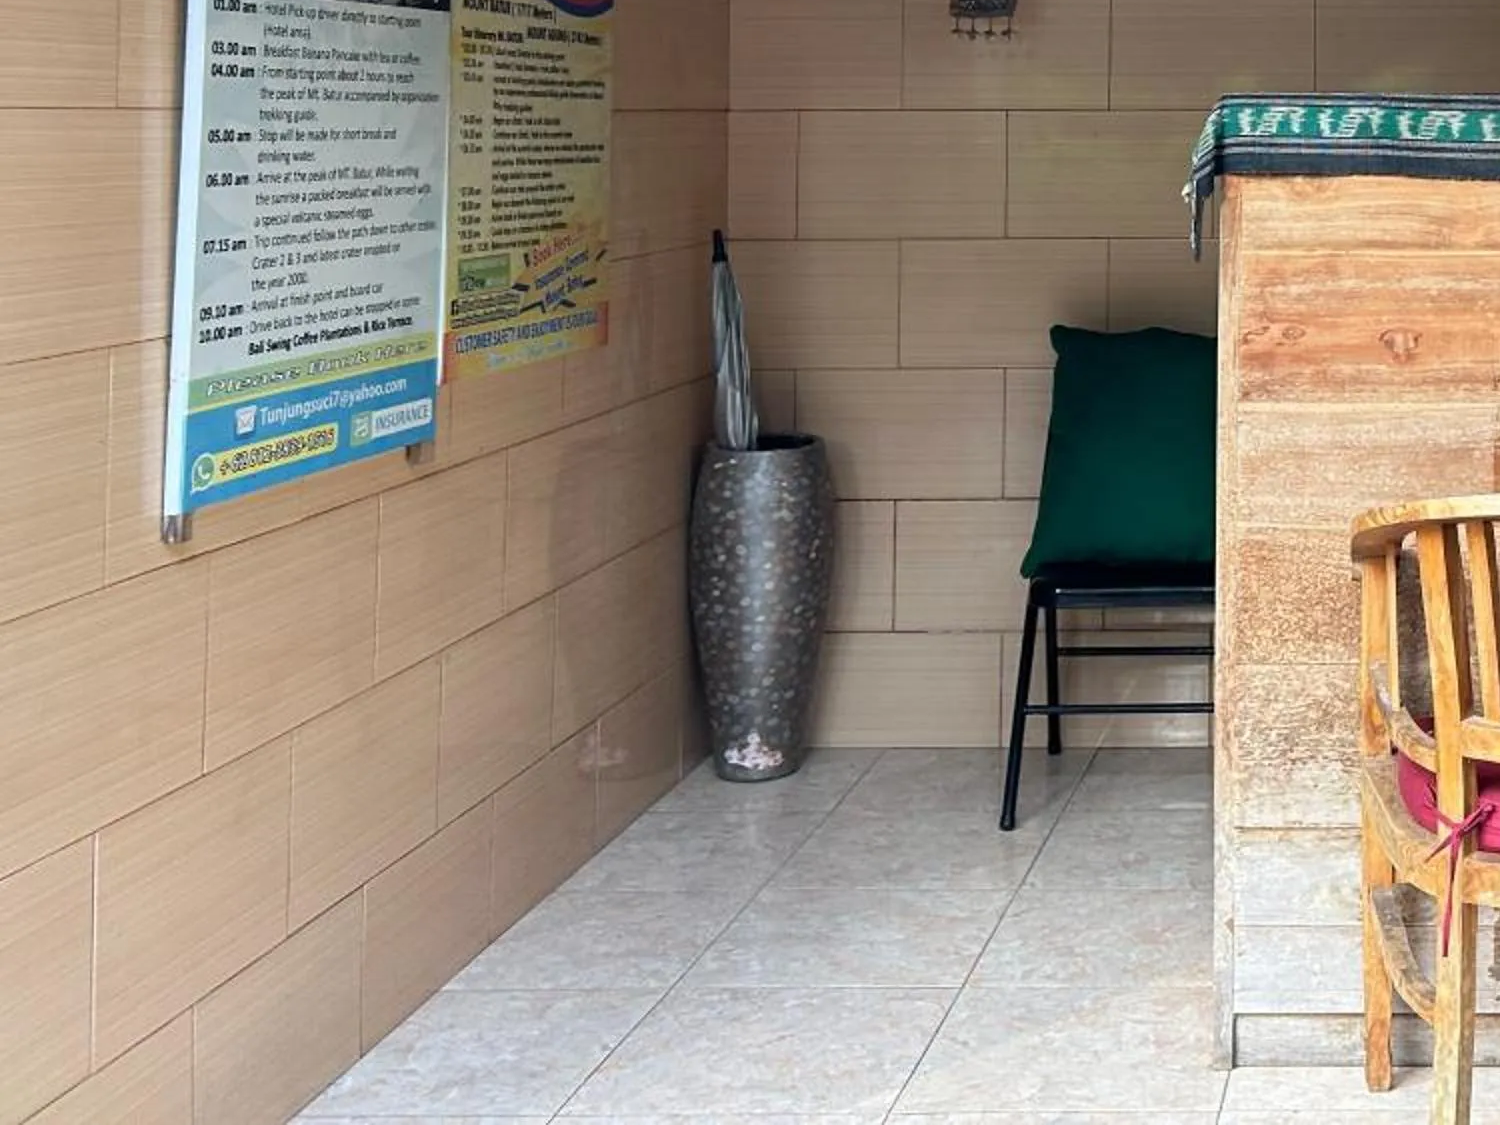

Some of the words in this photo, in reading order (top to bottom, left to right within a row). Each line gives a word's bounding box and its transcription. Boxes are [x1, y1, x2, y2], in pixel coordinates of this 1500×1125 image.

[242, 2, 257, 14] am
[241, 45, 257, 56] am
[240, 66, 255, 78] am
[236, 132, 252, 142] am
[234, 174, 249, 186] am
[203, 238, 230, 255] 07.15
[231, 239, 247, 252] am
[228, 304, 244, 316] am
[227, 326, 243, 338] am
[258, 377, 407, 427] Tunjungsuci7@yahoo.com
[375, 404, 429, 429] INSURANCE
